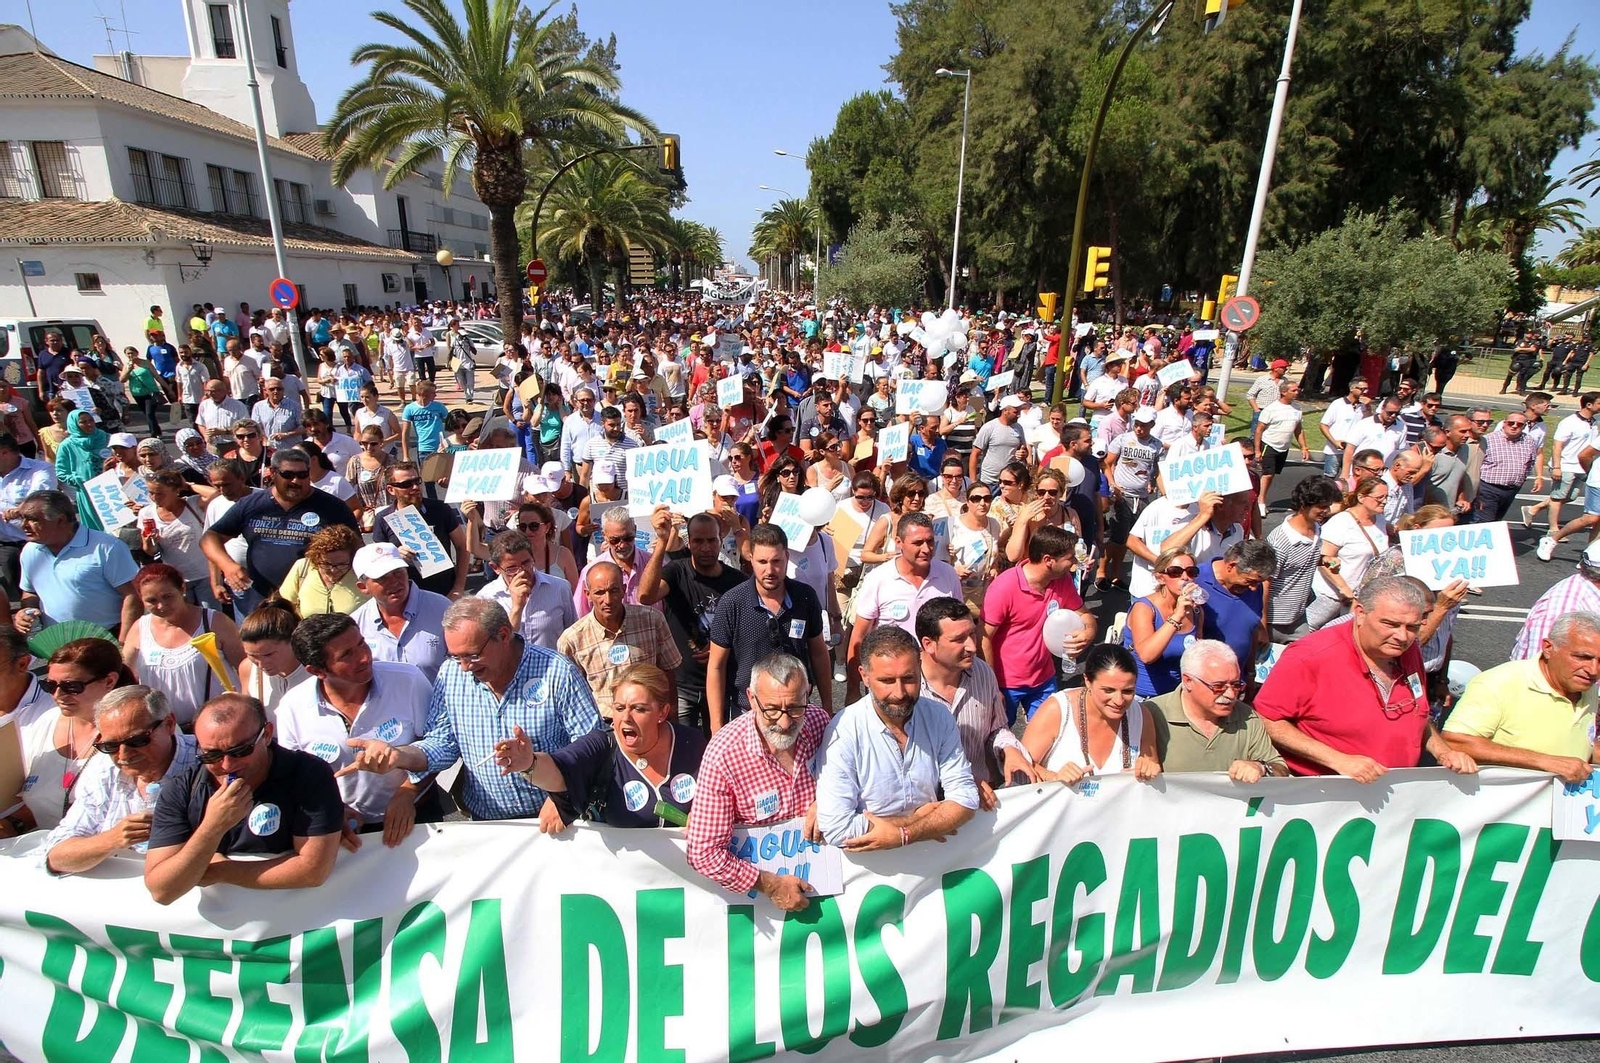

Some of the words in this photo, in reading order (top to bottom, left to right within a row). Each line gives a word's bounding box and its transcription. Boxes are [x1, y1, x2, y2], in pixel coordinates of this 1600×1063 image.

[458, 452, 512, 473] ¡¡AGUA
[634, 447, 699, 477] ¡¡AGUA
[1169, 450, 1234, 481] ¡¡AGUA
[465, 475, 502, 495] YA!!
[649, 477, 693, 505] YA!!
[1187, 473, 1230, 498] YA!!
[404, 513, 446, 563] ¡¡AGUA
[1410, 528, 1495, 556] ¡¡AGUA
[1431, 555, 1487, 580] YA!!
[374, 717, 399, 739] ¡¡AGUA
[382, 728, 398, 741] YA!!
[312, 742, 339, 753] ¡¡AGUA
[677, 788, 691, 801] YA!!
[250, 806, 279, 828] ¡¡AGUA
[259, 820, 275, 834] YA!!
[26, 899, 514, 1063] DEFENSA
[560, 887, 686, 1063] DE
[727, 885, 909, 1061] LOS
[936, 796, 1376, 1042] REGADÍOS
[1383, 818, 1562, 977] DEL
